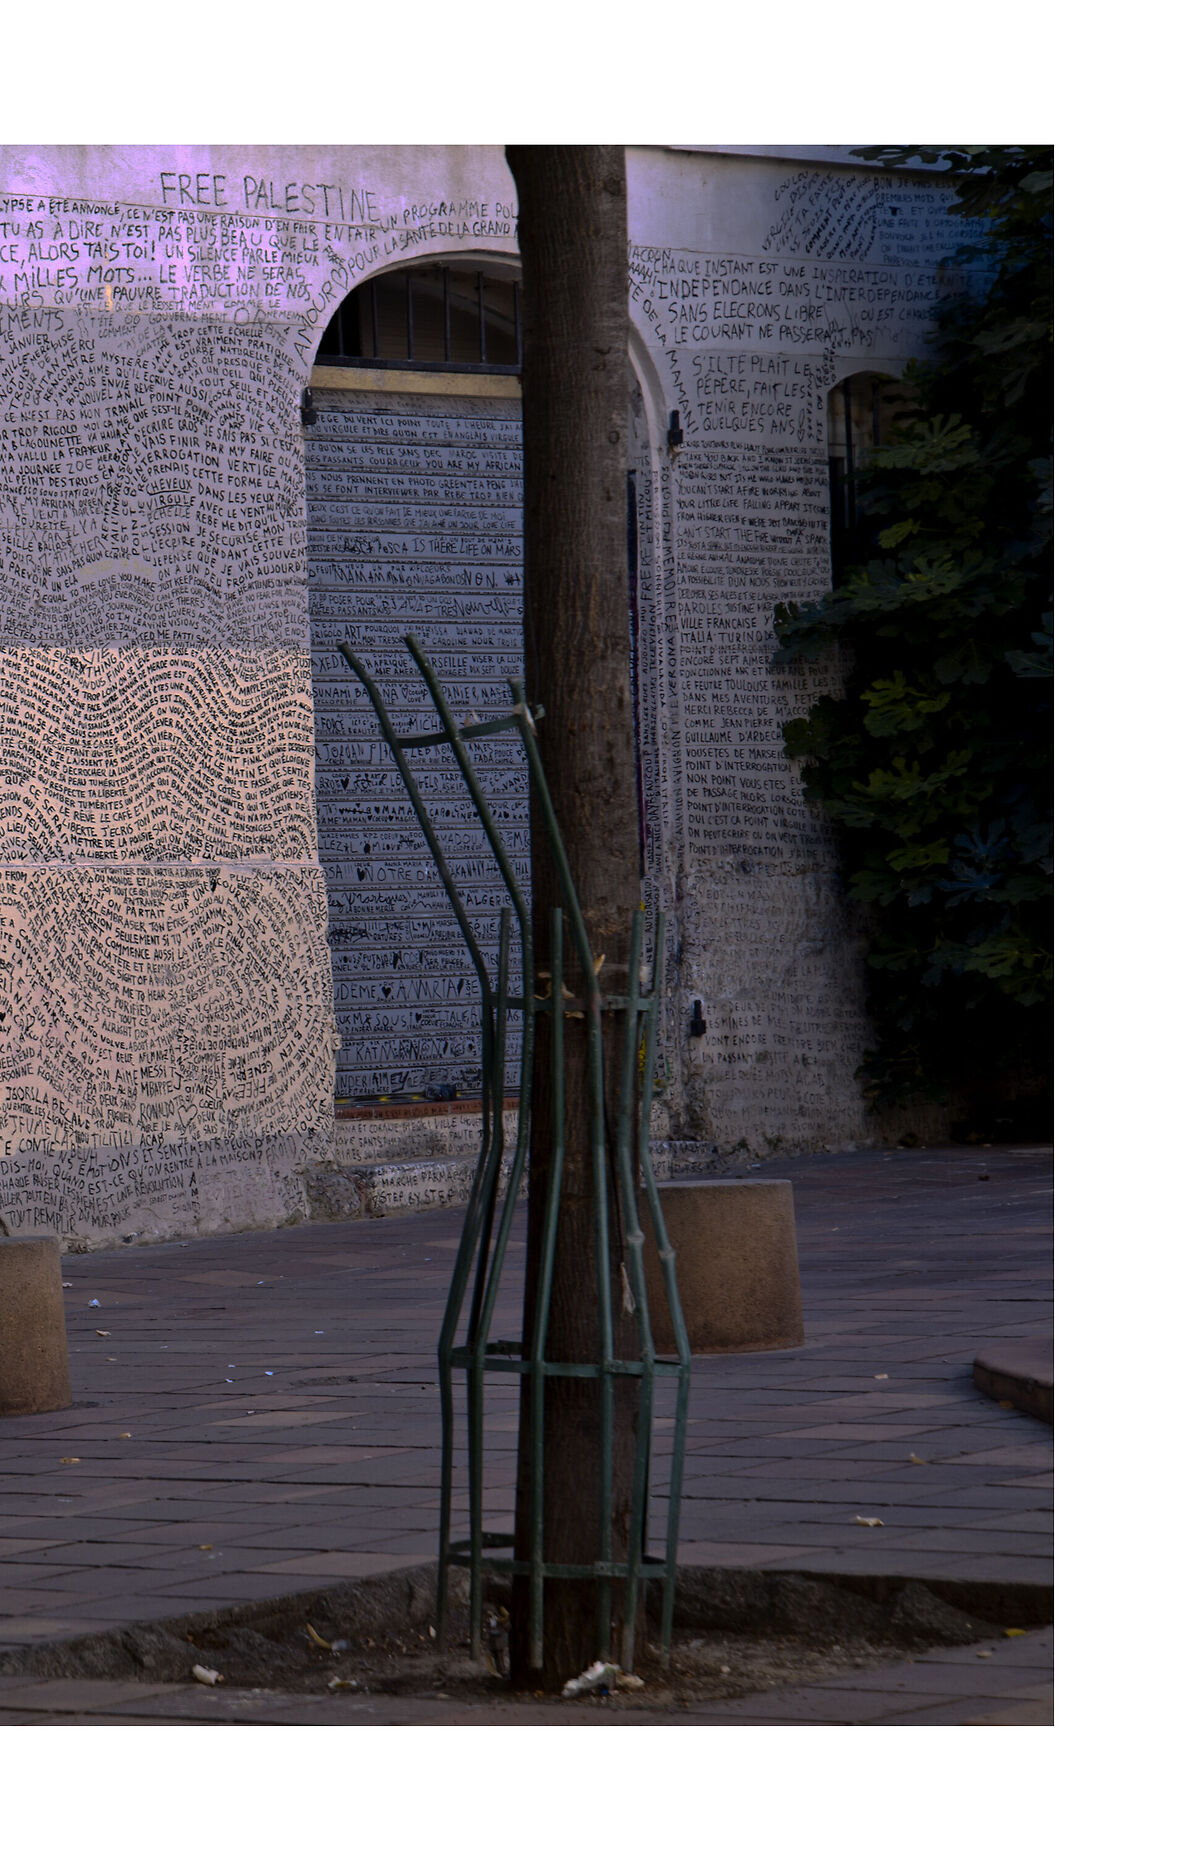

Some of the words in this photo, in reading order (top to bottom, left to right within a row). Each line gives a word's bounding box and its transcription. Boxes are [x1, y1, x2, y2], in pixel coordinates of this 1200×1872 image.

[160, 172, 228, 206] FREE
[244, 175, 382, 223] PALESTINE
[403, 202, 488, 225] PROGRAMME
[0, 219, 20, 238] TU
[24, 221, 44, 239] AS
[110, 224, 148, 239] N'EST
[158, 224, 185, 244] PAS
[187, 224, 217, 246] PLUS
[221, 229, 262, 248] BEAU
[268, 235, 296, 250] QUE
[303, 238, 319, 250] LE
[28, 242, 80, 264] ALORS
[165, 244, 184, 259] UN
[188, 247, 238, 264] SILENCE
[241, 248, 278, 263] PARLE
[281, 249, 320, 267] MIEUX
[159, 265, 177, 284] LE
[183, 266, 230, 283] VERBE
[262, 265, 306, 283] SERAS
[653, 258, 700, 276] CHAQUE
[705, 260, 754, 277] INSTANT
[760, 263, 778, 276] EST
[784, 265, 805, 278] UNE
[812, 267, 897, 286] INSPIRATION
[112, 286, 161, 301] PAUVRE
[168, 282, 258, 300] TRADUCTION
[265, 284, 282, 296] DE
[658, 280, 772, 299] INDEPENDANCE
[779, 281, 810, 296] DANS
[668, 301, 707, 323] SANS
[713, 301, 780, 320] ELECRONS
[674, 326, 689, 345] LE
[693, 324, 754, 341] COURANT
[742, 402, 792, 417] ENCORE
[703, 418, 765, 433] QUELQUES
[770, 418, 795, 434] ANS
[228, 460, 276, 477] VERTIGE
[428, 540, 457, 554] THERE
[495, 545, 520, 557] MARS
[681, 618, 703, 629] VILLE
[707, 618, 757, 629] FRANCAISE
